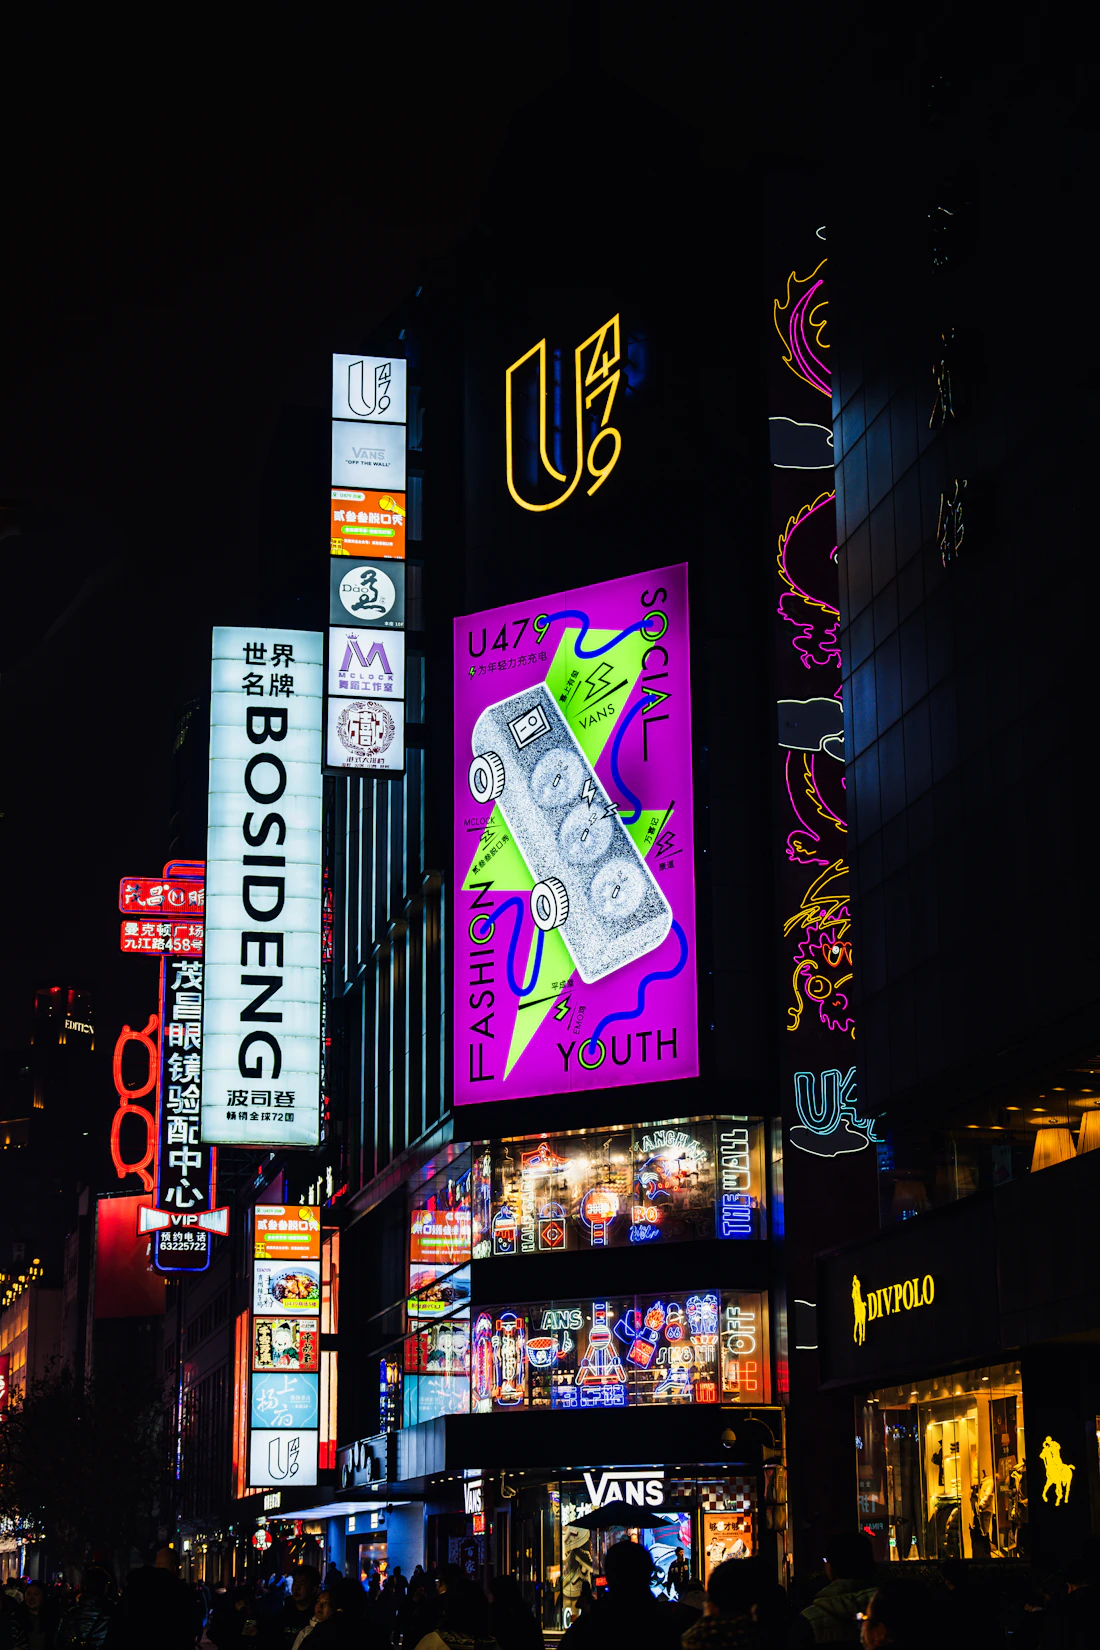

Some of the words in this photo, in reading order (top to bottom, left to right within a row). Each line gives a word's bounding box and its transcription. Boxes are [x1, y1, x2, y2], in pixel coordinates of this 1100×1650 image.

[352, 446, 386, 460] VANS
[468, 613, 551, 658] U479
[243, 642, 295, 668] 世界
[241, 672, 295, 698] 名牌
[338, 672, 394, 681] MCLOCK
[338, 680, 393, 692] 舞蹈工作室
[640, 588, 673, 762] SOCIAL
[578, 703, 616, 729] VANS
[463, 816, 496, 827] MCLOCK
[238, 706, 288, 1079] BOSIDENG
[468, 880, 495, 1082] FASHION
[556, 1027, 678, 1072] YOUTH
[227, 1090, 296, 1108] 波司登
[171, 1214, 199, 1226] VIP
[160, 1242, 207, 1252] 63225722
[161, 1232, 207, 1242] 预约电话
[866, 1274, 935, 1321] DIV.POLO
[464, 1479, 482, 1515] VANS
[583, 1471, 664, 1507] VANS
